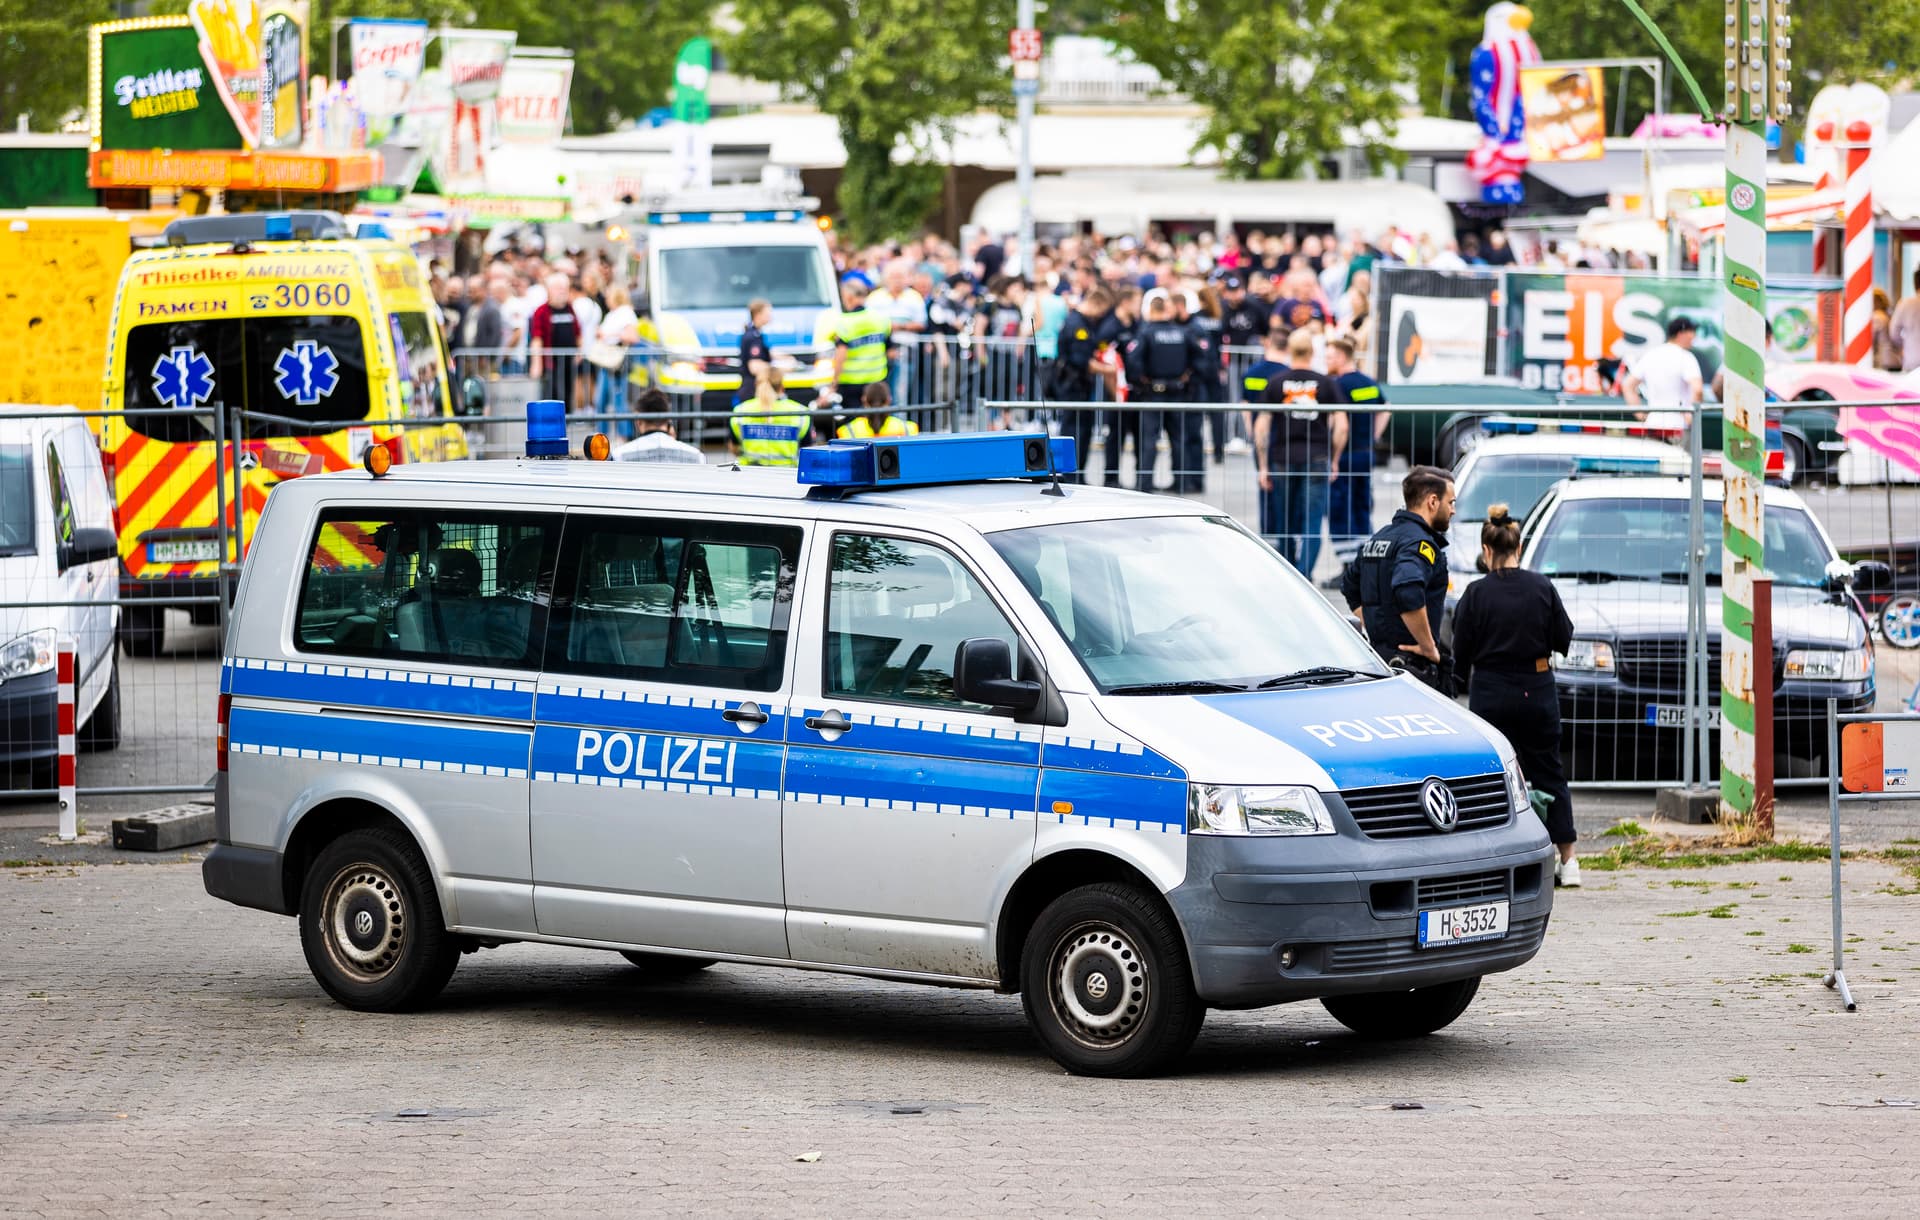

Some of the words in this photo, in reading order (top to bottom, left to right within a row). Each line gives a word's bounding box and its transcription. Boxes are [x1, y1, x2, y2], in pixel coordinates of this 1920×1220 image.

[137, 268, 238, 287] Thiedke
[245, 264, 350, 278] AMBULANZ
[1523, 289, 1665, 361] EIS
[1302, 713, 1459, 748] POLIZEI
[576, 730, 737, 784] POLIZEI
[1441, 912, 1452, 936] H
[1461, 907, 1498, 933] 3532
